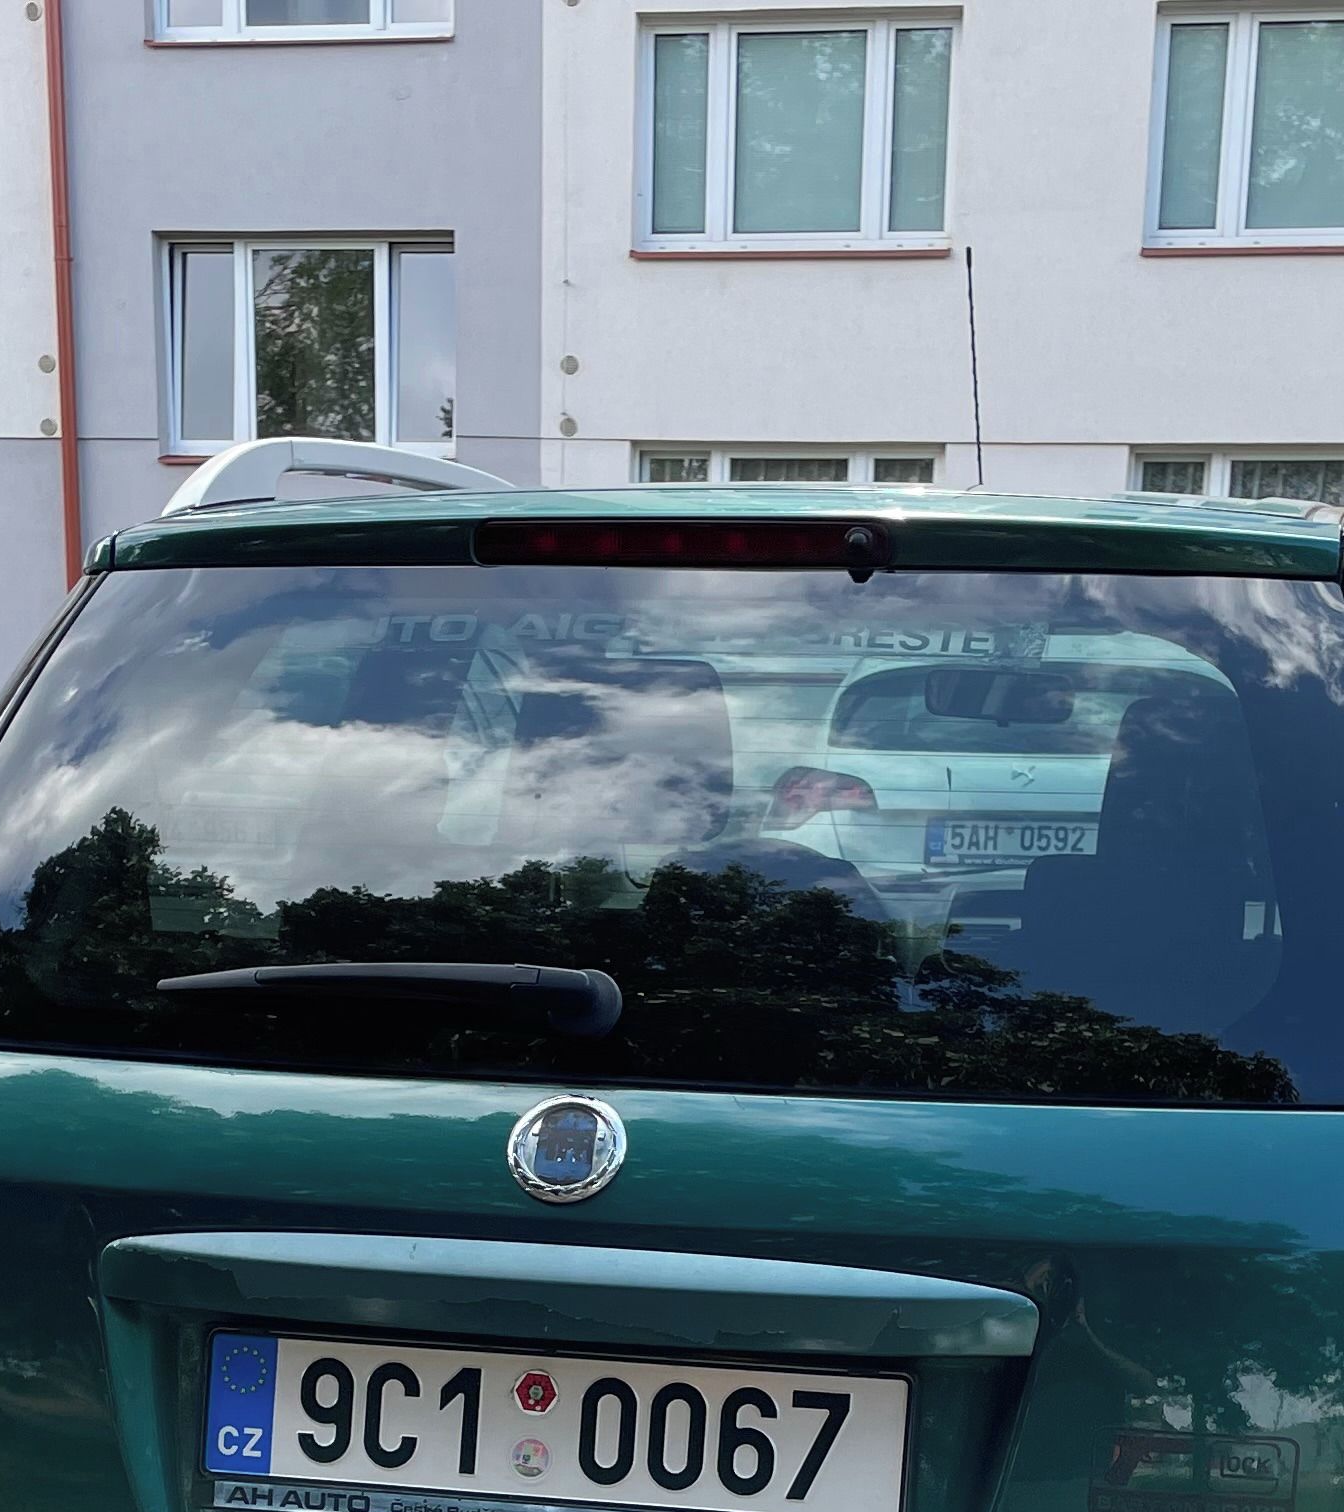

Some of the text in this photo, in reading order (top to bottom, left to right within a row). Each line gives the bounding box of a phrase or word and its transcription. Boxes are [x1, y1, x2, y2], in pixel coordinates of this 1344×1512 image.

[950, 824, 1086, 852] 5AH 0592
[217, 1425, 263, 1458] CZ
[298, 1357, 852, 1500] 9C1 0067
[226, 1486, 274, 1506] AH
